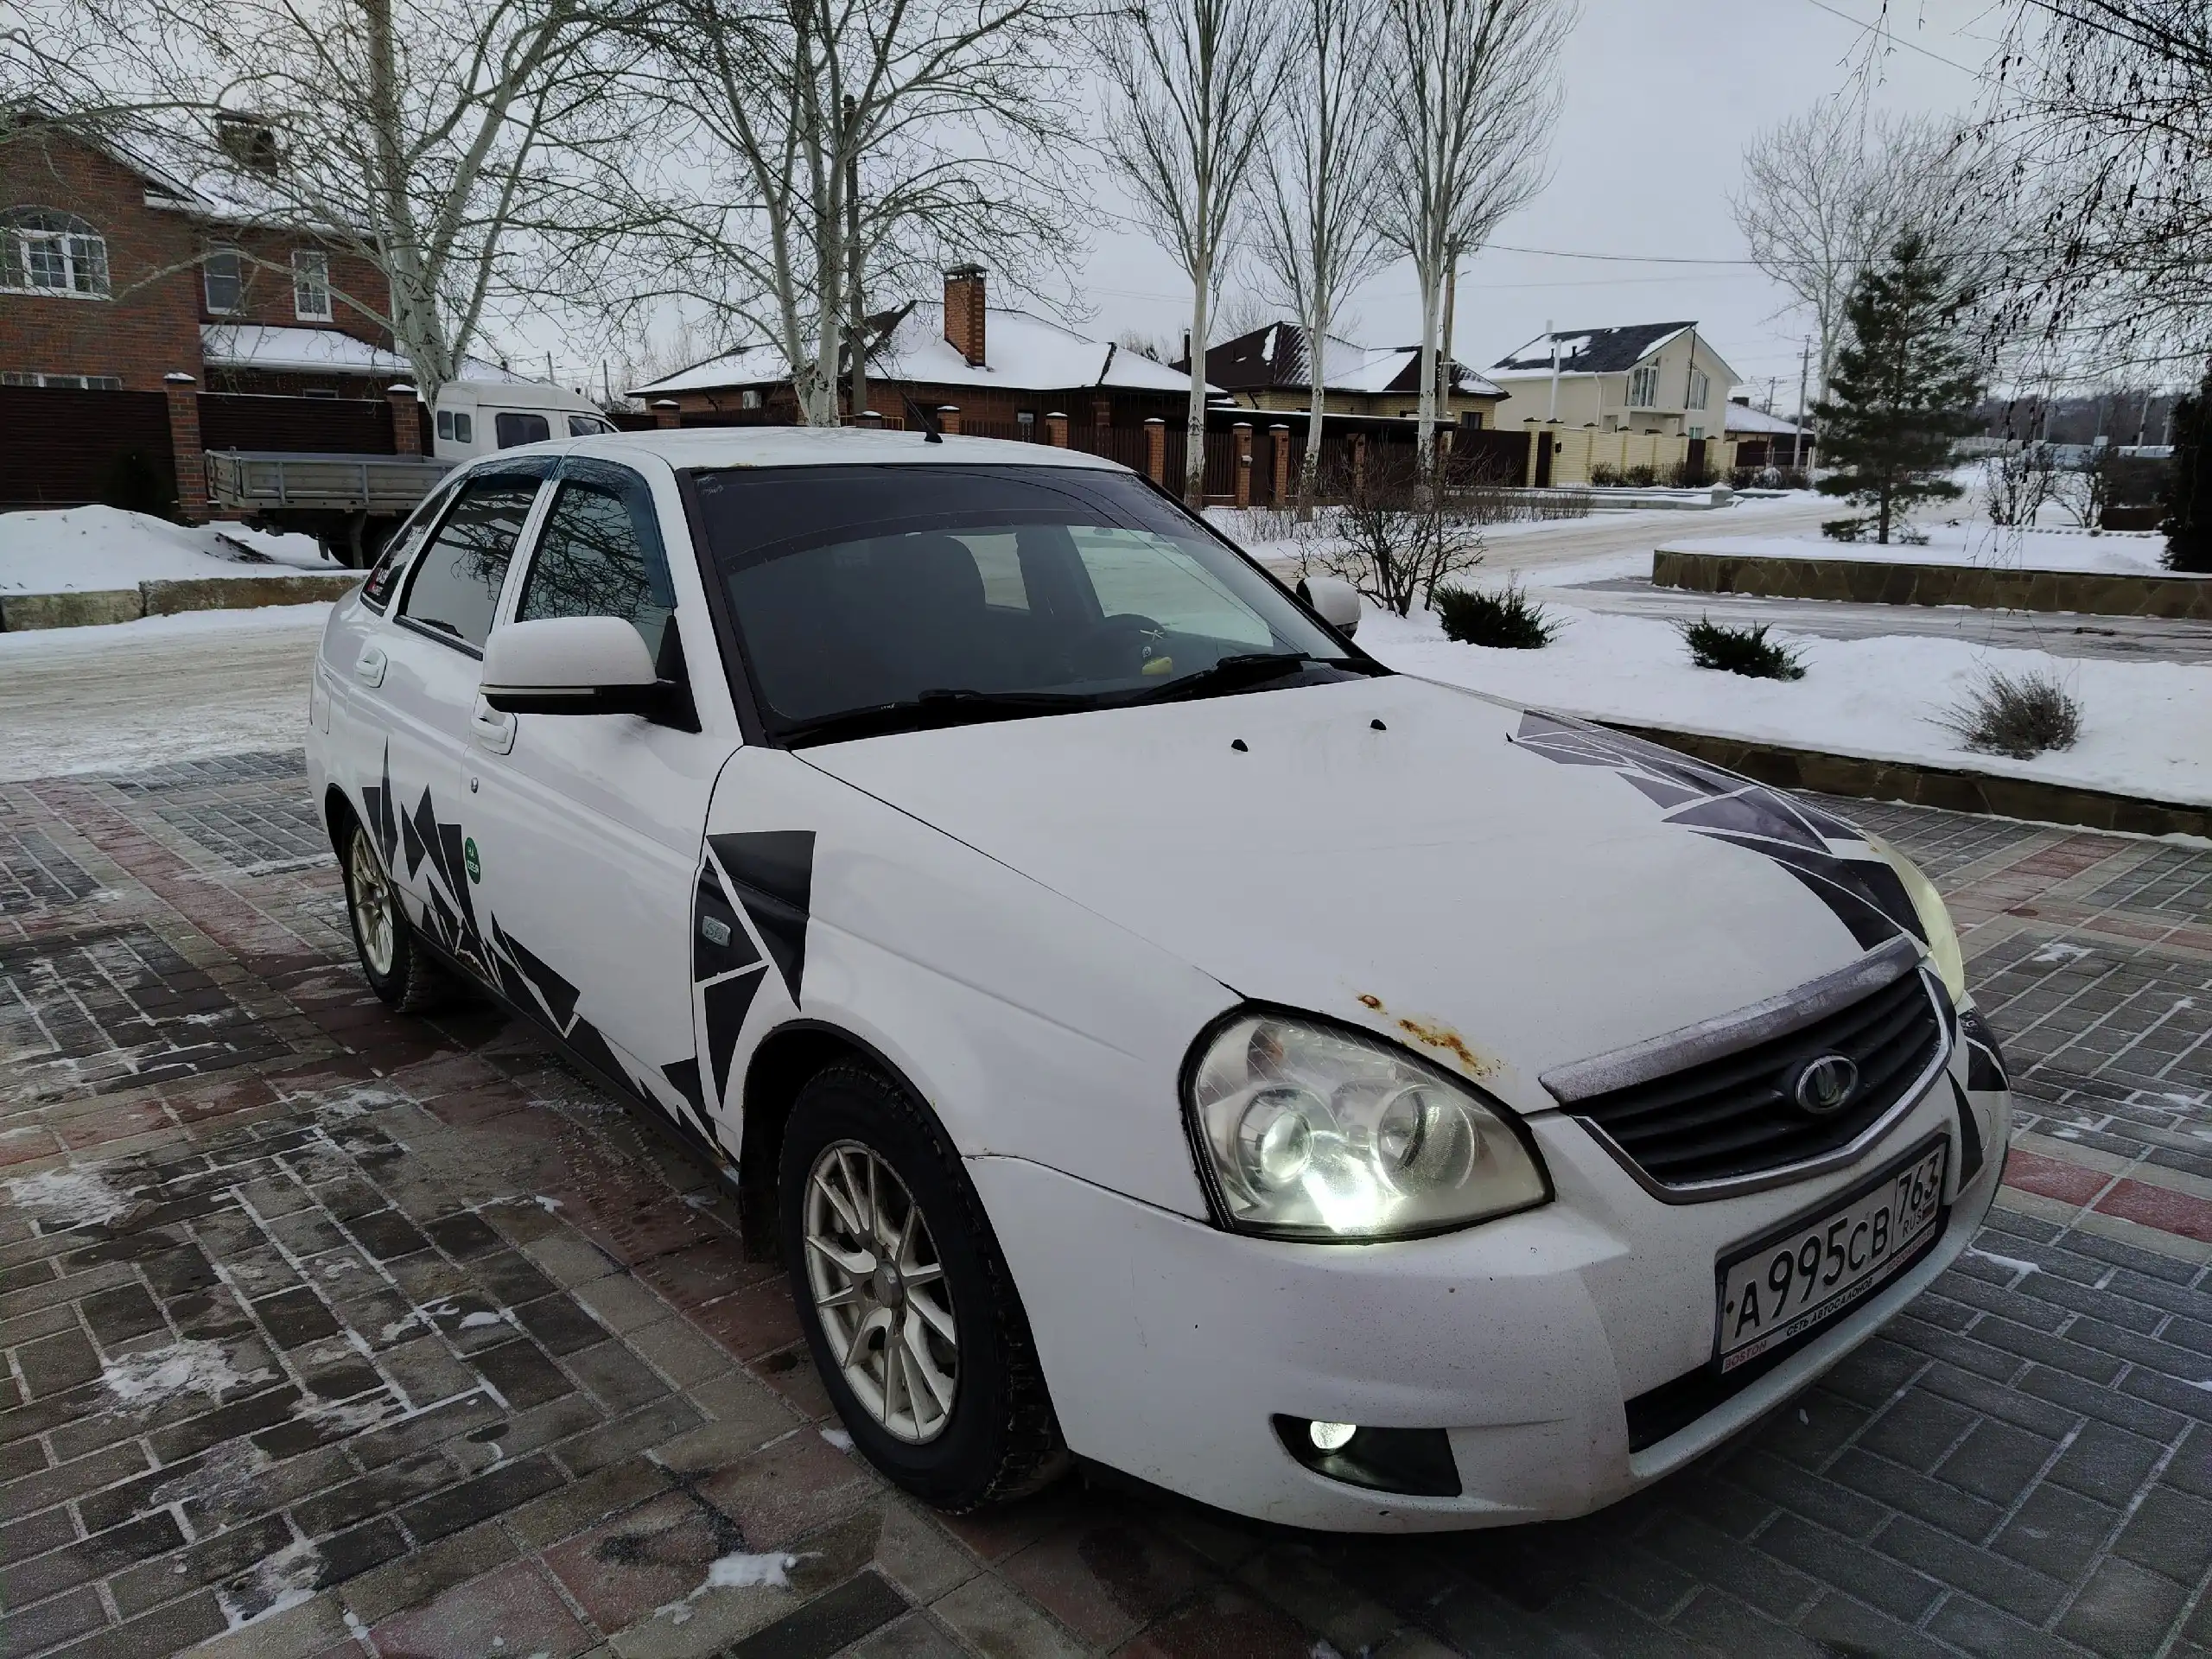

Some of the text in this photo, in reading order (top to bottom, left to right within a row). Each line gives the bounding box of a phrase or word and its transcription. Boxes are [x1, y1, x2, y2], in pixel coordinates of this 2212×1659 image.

[1735, 1206, 1890, 1338] А995СВ
[1898, 1152, 1939, 1224] 763
[1903, 1208, 1923, 1238] RUS
[1786, 1277, 1873, 1337] СЕТЬ АВТОСАЛОНОВ
